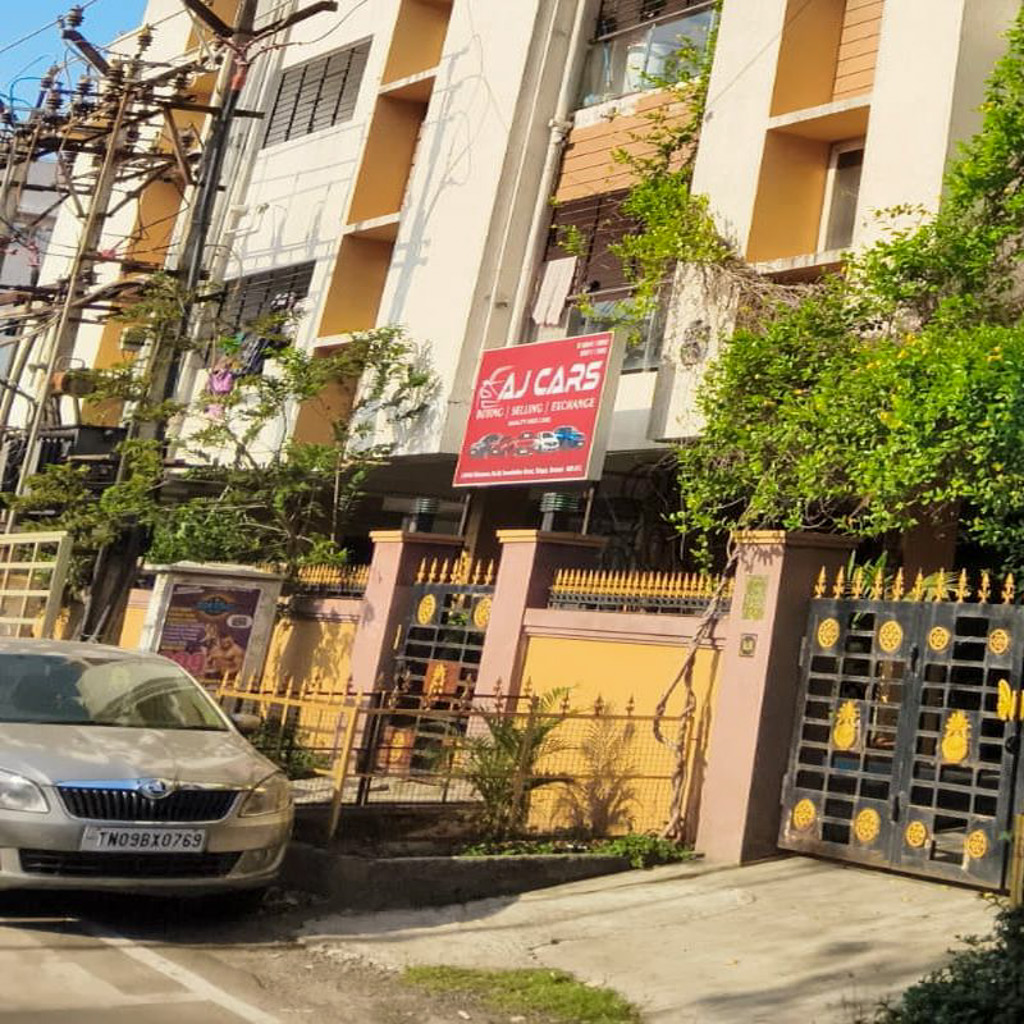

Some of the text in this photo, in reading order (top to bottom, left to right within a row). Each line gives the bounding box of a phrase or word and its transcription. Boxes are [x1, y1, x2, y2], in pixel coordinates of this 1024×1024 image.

[497, 361, 603, 400] AJ CARS
[551, 397, 596, 412] EXCHANGE
[99, 831, 203, 848] TN09BX0769
